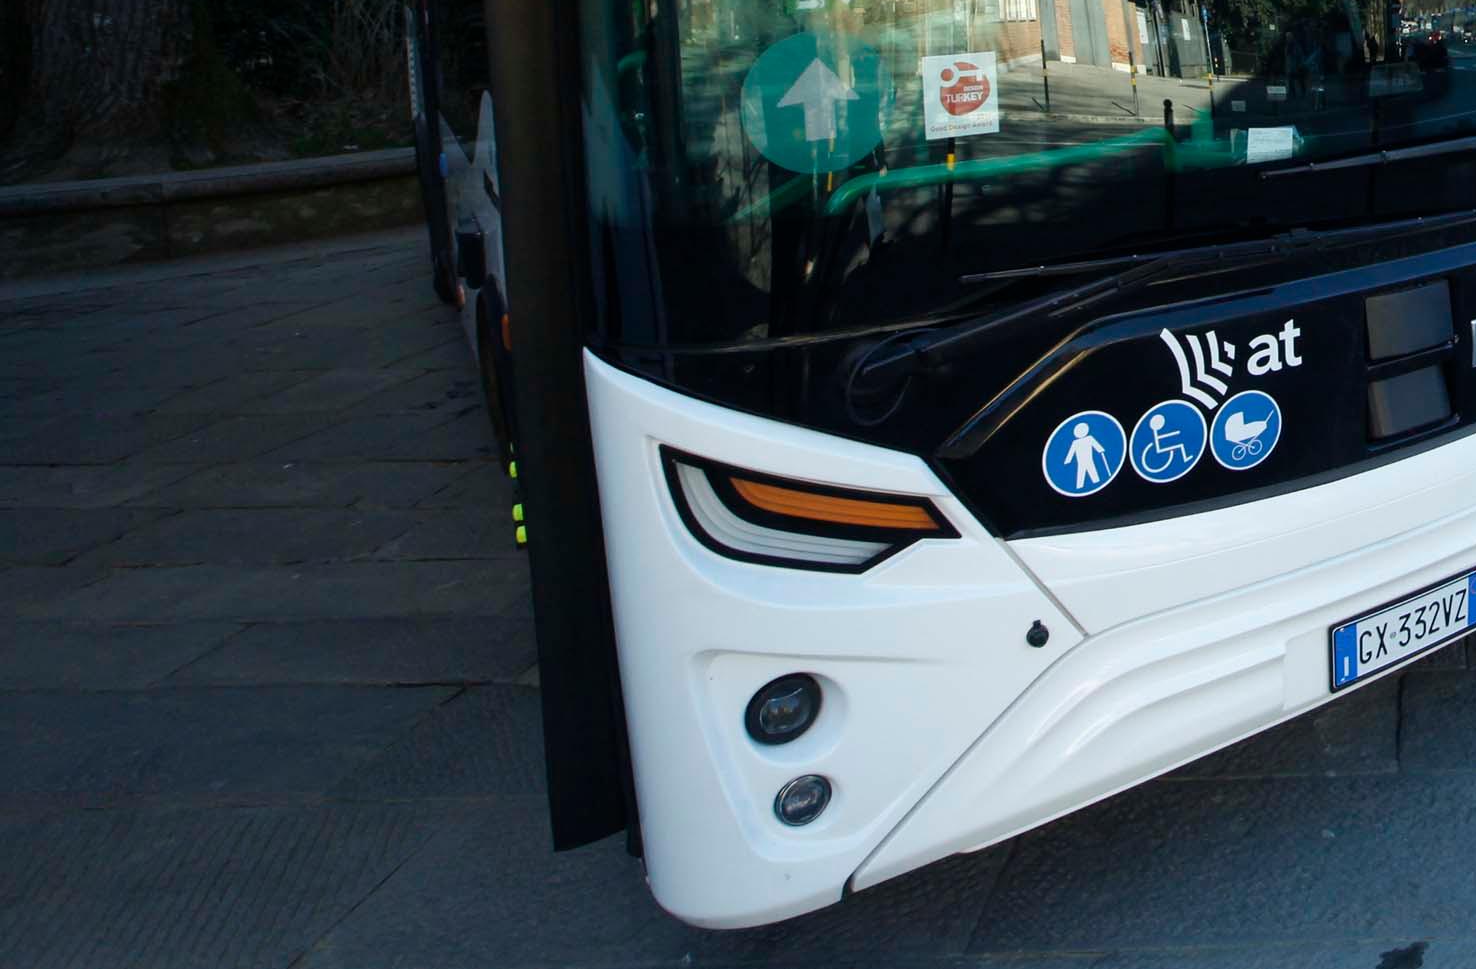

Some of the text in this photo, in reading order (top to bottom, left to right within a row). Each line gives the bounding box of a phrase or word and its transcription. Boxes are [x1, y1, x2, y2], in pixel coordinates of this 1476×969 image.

[944, 91, 984, 104] TURKEY
[1247, 318, 1303, 376] at
[1358, 622, 1389, 664] GX
[1398, 588, 1468, 648] 332VZ
